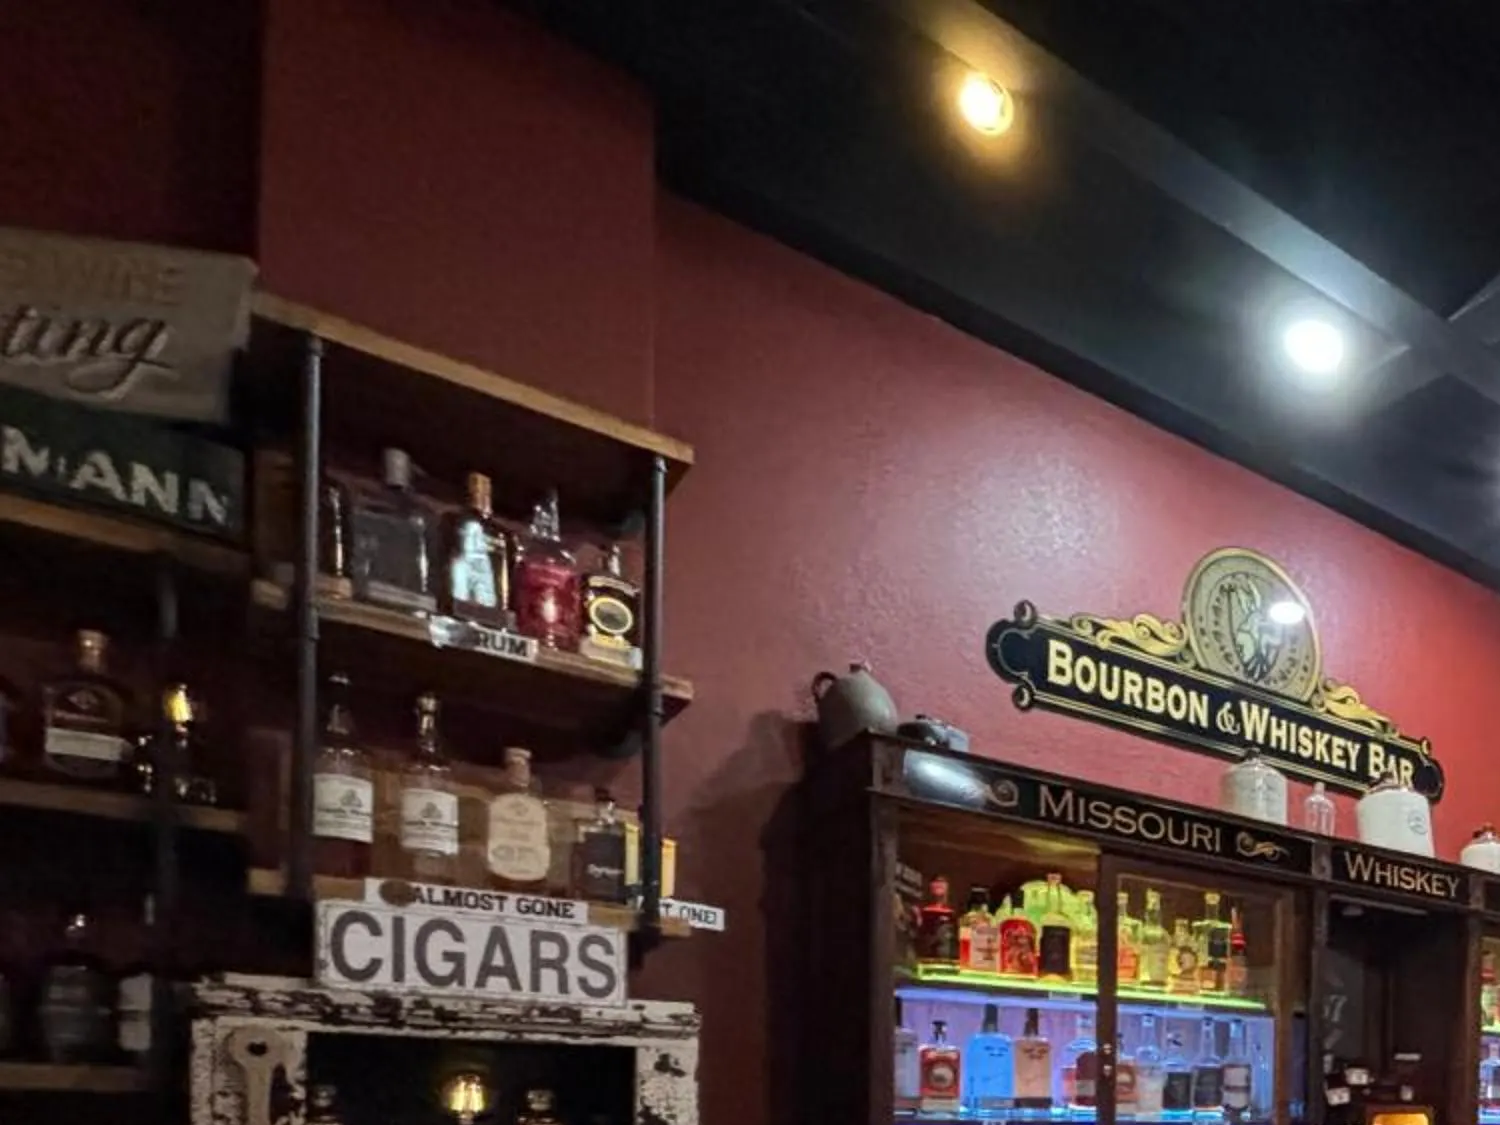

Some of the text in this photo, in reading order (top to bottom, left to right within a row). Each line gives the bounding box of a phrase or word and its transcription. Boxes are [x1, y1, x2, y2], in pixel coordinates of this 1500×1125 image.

[479, 630, 527, 657] RUM
[1047, 639, 1210, 729] BOURBON
[1216, 702, 1241, 735] &
[1239, 700, 1360, 773] WHISKEY
[1368, 743, 1414, 785] BAR
[1037, 783, 1222, 854] MISSOURI
[413, 886, 576, 920] ALMOST GONE
[1345, 851, 1460, 899] WHISKEY
[330, 909, 617, 999] CIGARS
